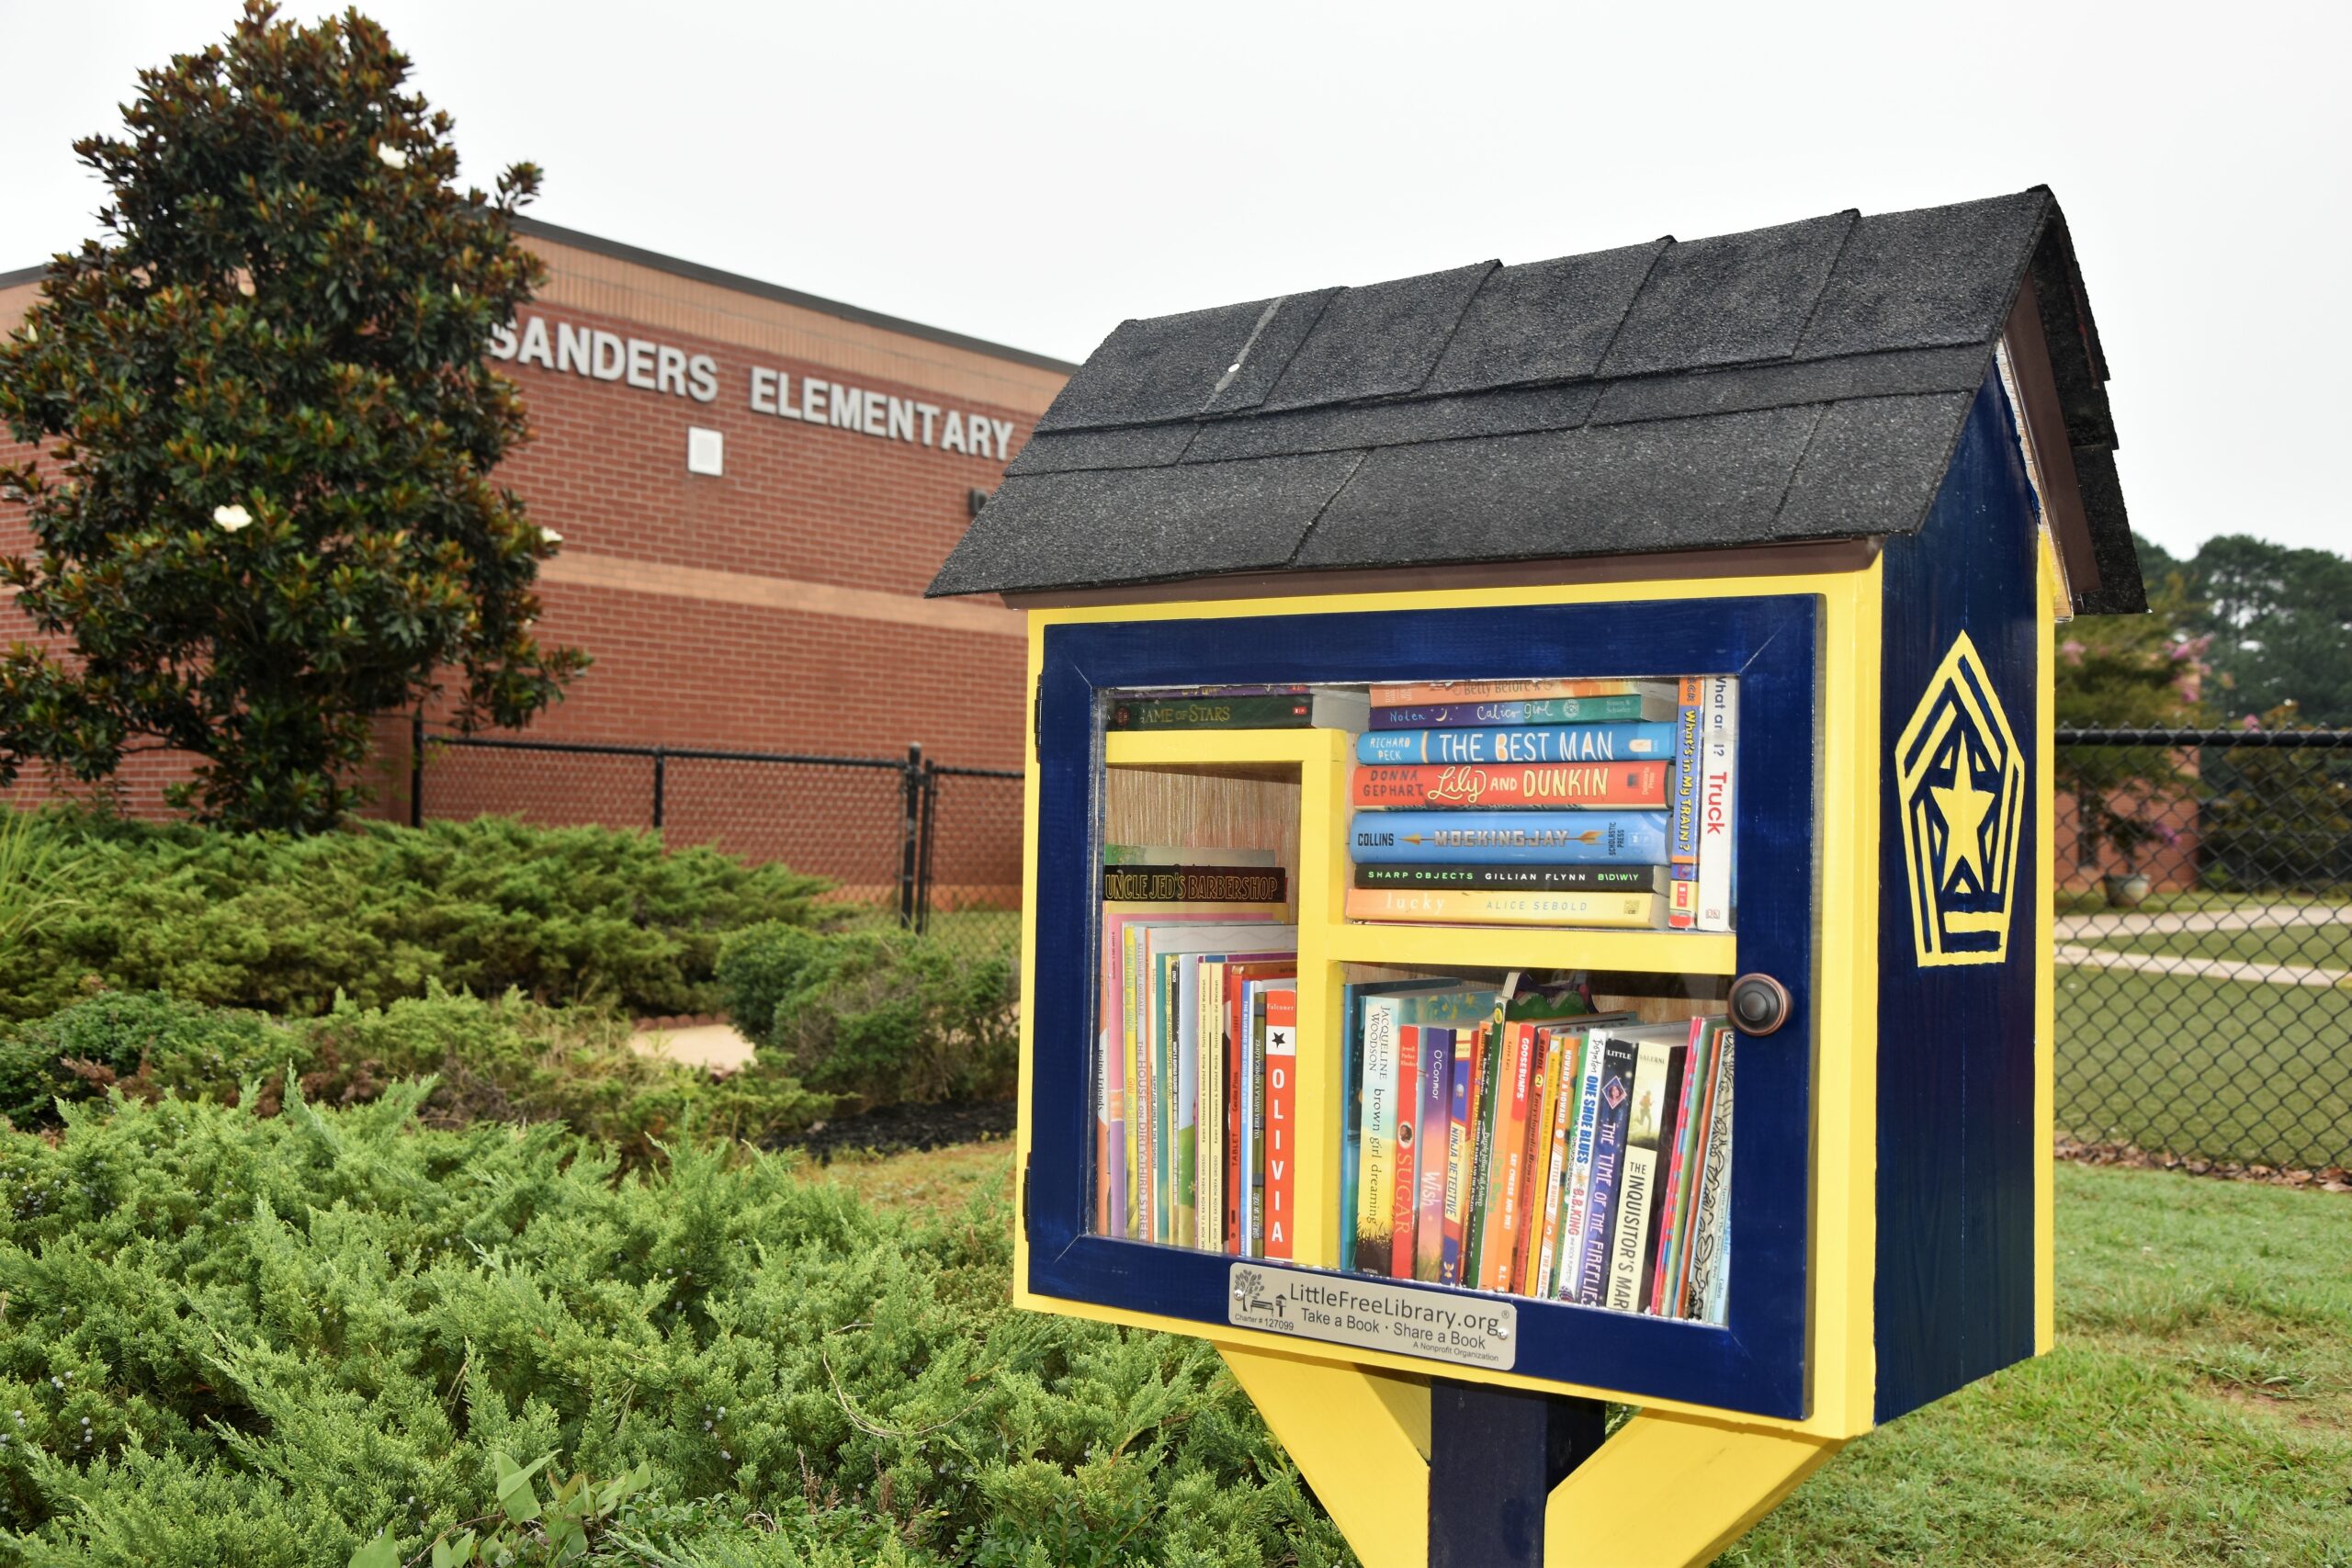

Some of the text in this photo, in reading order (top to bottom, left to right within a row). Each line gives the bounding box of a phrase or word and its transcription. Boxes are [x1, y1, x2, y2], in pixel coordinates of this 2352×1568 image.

[487, 316, 1014, 461] SANDERS ELEMENTARY
[1189, 704, 1231, 724] STARS
[1389, 711, 1427, 723] Nolen
[1476, 704, 1521, 721] Calico
[1370, 737, 1411, 749] RICHARD
[1439, 731, 1614, 761] THE BEST MAN
[1684, 710, 1696, 756] What's
[1377, 750, 1402, 761] PECK
[1682, 759, 1693, 773] in
[1363, 783, 1424, 797] GEPHART
[1371, 769, 1419, 782] DONNA
[1427, 765, 1609, 804] Lily AND DUNKIN
[1679, 776, 1693, 796] My
[1707, 772, 1727, 835] Truck
[1357, 829, 1569, 848] COLLINS MOCKINGJAY
[1609, 822, 1617, 856] SCHOLASTIC
[1105, 872, 1278, 901] UNCLE JED'S BARBERSHOP
[1368, 871, 1409, 879] SHARP
[1415, 872, 1475, 880] OBJECTS
[1485, 873, 1537, 881] GILLIAN
[1385, 891, 1588, 915] lucky ALICE SEBOLD
[1267, 1003, 1295, 1011] Falconer
[1368, 1012, 1380, 1072] WOODSON
[1378, 1005, 1391, 1080] JACQUELINE
[1537, 1038, 1546, 1070] SOBOL
[1590, 1039, 1604, 1073] Boynton
[1608, 1050, 1632, 1060] LITTLE
[1516, 1037, 1530, 1100] GOOSEBUMPS
[1563, 1049, 1573, 1082] HOWARD
[1137, 1060, 1147, 1101] HOUSE
[1535, 1076, 1543, 1086] 2
[1584, 1075, 1600, 1099] ONE
[1138, 1106, 1145, 1119] ON
[1558, 1091, 1569, 1124] HOWARD
[1579, 1099, 1597, 1132] SHOE
[1421, 1049, 1443, 1207] O'Connor Wish
[1528, 1092, 1543, 1153] Encyclopedia
[1600, 1122, 1616, 1146] THE
[1138, 1122, 1148, 1195] DIRTY-THIRD
[1271, 1068, 1286, 1243] OLIVIA
[1366, 1089, 1385, 1225] brown girl dreaming
[1510, 1153, 1518, 1168] SAY
[1577, 1131, 1593, 1165] BLUES
[1445, 1126, 1460, 1217] NINJA DETECTIVE
[1507, 1168, 1516, 1197] CHEESE
[1525, 1154, 1535, 1183] Brown
[1552, 1159, 1560, 1179] LITTLE
[1595, 1153, 1616, 1188] TIME
[1629, 1162, 1647, 1175] THE
[1394, 1153, 1412, 1235] SUGAR
[1505, 1198, 1514, 1213] AND
[1549, 1180, 1558, 1209] RHINO
[1593, 1191, 1608, 1208] OF
[1503, 1214, 1511, 1230] DIE!
[1545, 1225, 1553, 1235] 5
[1589, 1212, 1605, 1235] THE
[1618, 1174, 1645, 1273] INQUISITOR'S
[1542, 1254, 1551, 1268] THE
[1234, 1313, 1257, 1324] Charter
[1264, 1318, 1295, 1331] 127099
[1290, 1282, 1499, 1337] LittleFreeLibrary.org
[1301, 1307, 1486, 1349] Take a Book Share a Book
[1420, 1342, 1453, 1355] Nonprofit
[1453, 1348, 1499, 1361] Organization
